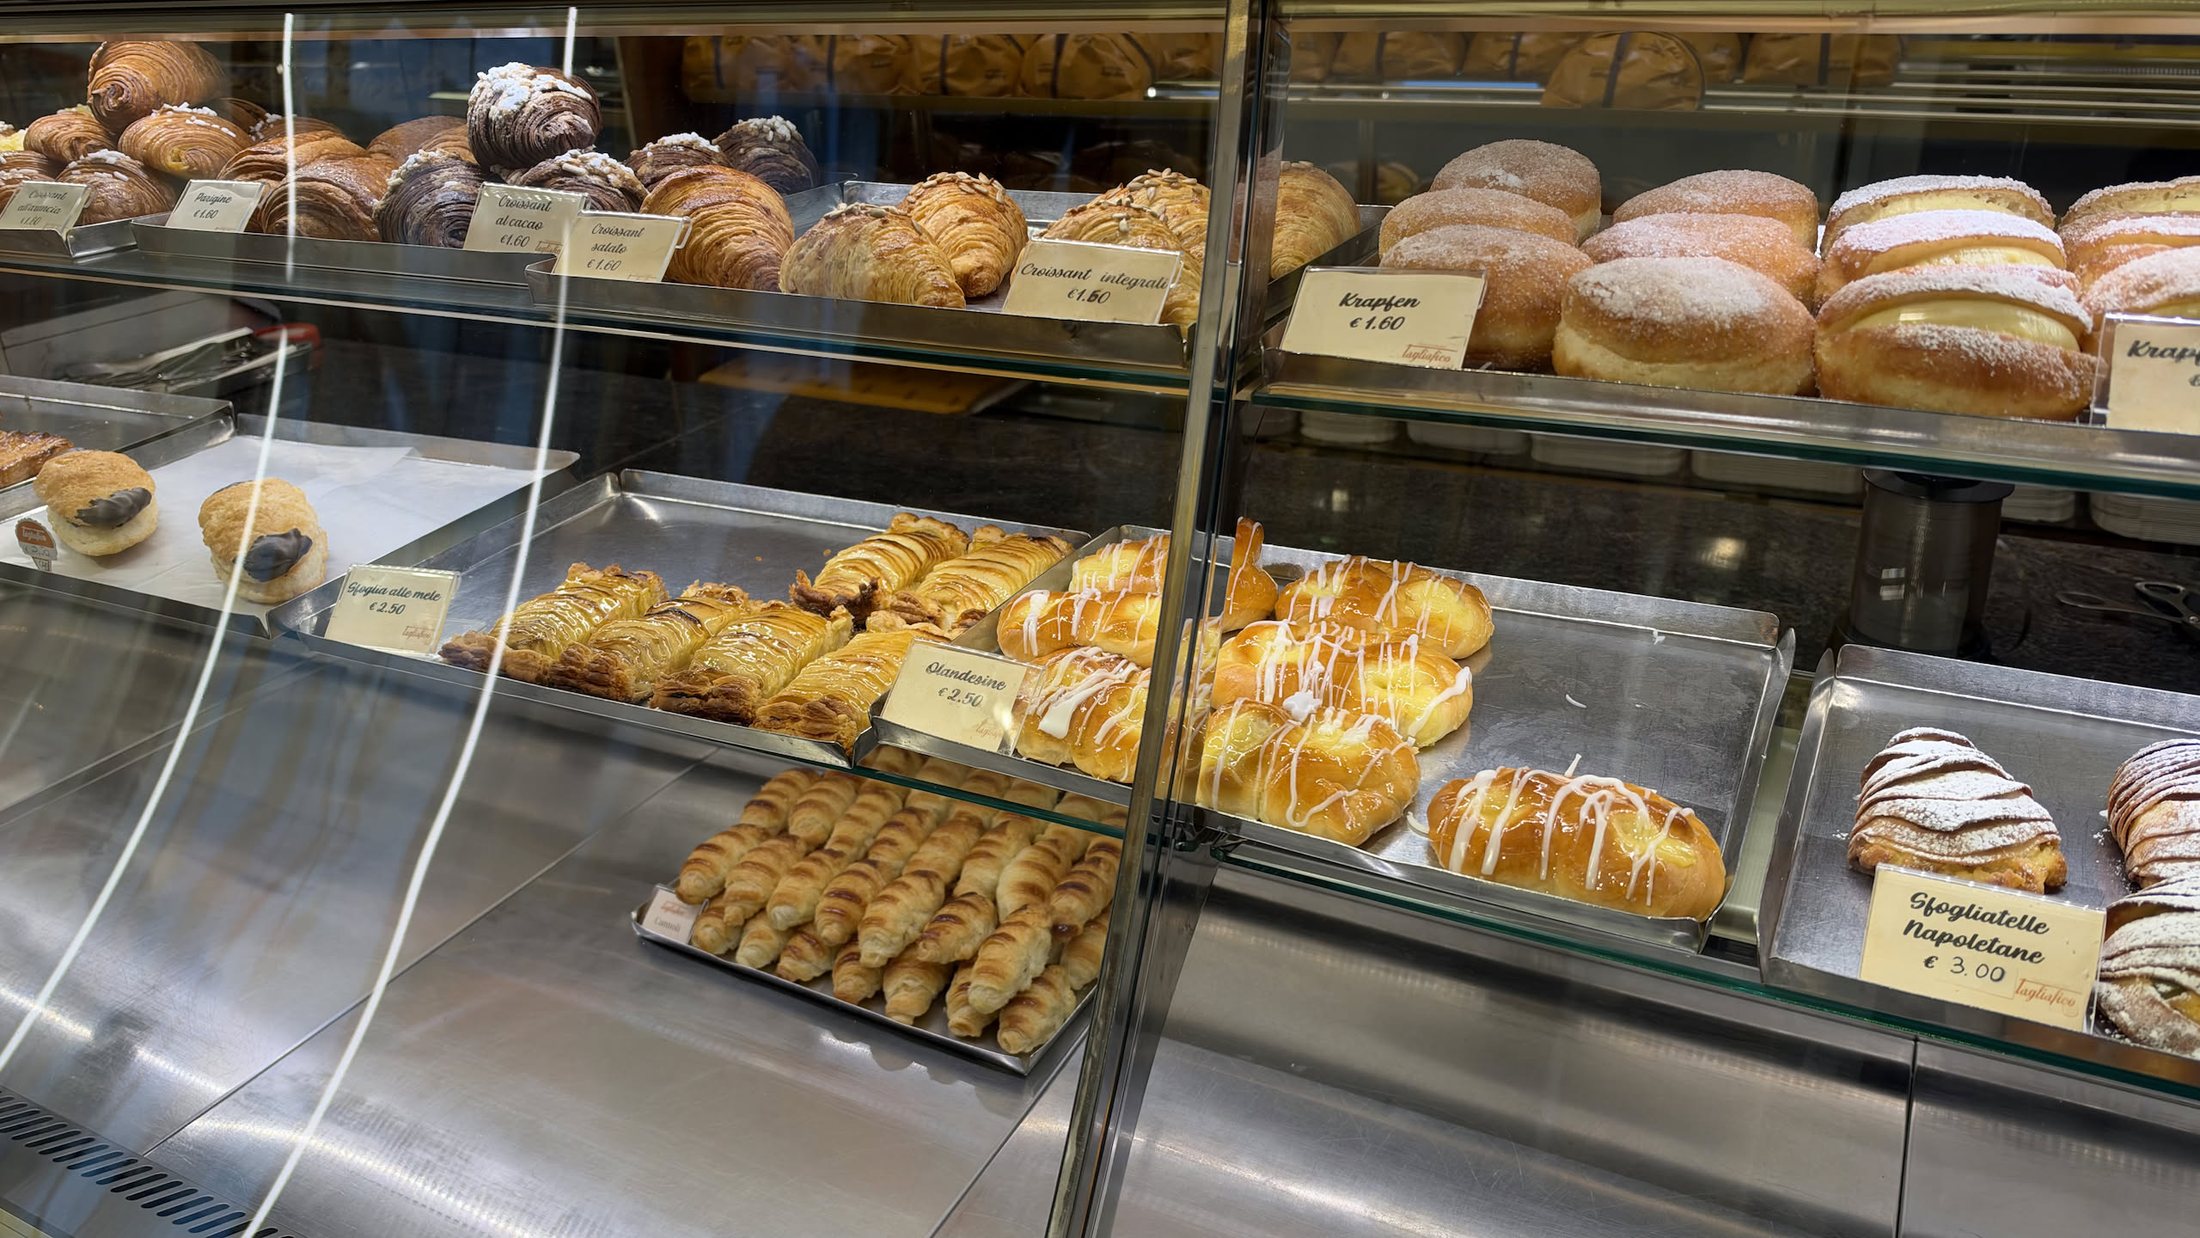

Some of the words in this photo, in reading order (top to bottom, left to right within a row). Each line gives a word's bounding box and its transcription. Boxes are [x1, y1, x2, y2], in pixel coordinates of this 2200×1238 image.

[194, 192, 233, 205] Parigine
[498, 195, 552, 212] Croissant
[495, 215, 509, 225] al
[509, 220, 544, 231] cacao
[592, 223, 645, 238] Croissant
[591, 242, 627, 254] salato
[1021, 263, 1092, 281] Croissant
[1100, 272, 1169, 290] integrali
[1339, 292, 1421, 312] Krapfen
[347, 582, 389, 596] Sfoglia
[389, 585, 412, 599] alle
[412, 590, 441, 602] mele
[925, 661, 1007, 692] Olandesine
[1910, 892, 2050, 935] Sfogliatelle
[1903, 919, 2046, 965] Napoletane
[2015, 977, 2078, 1009] Tagliafico
